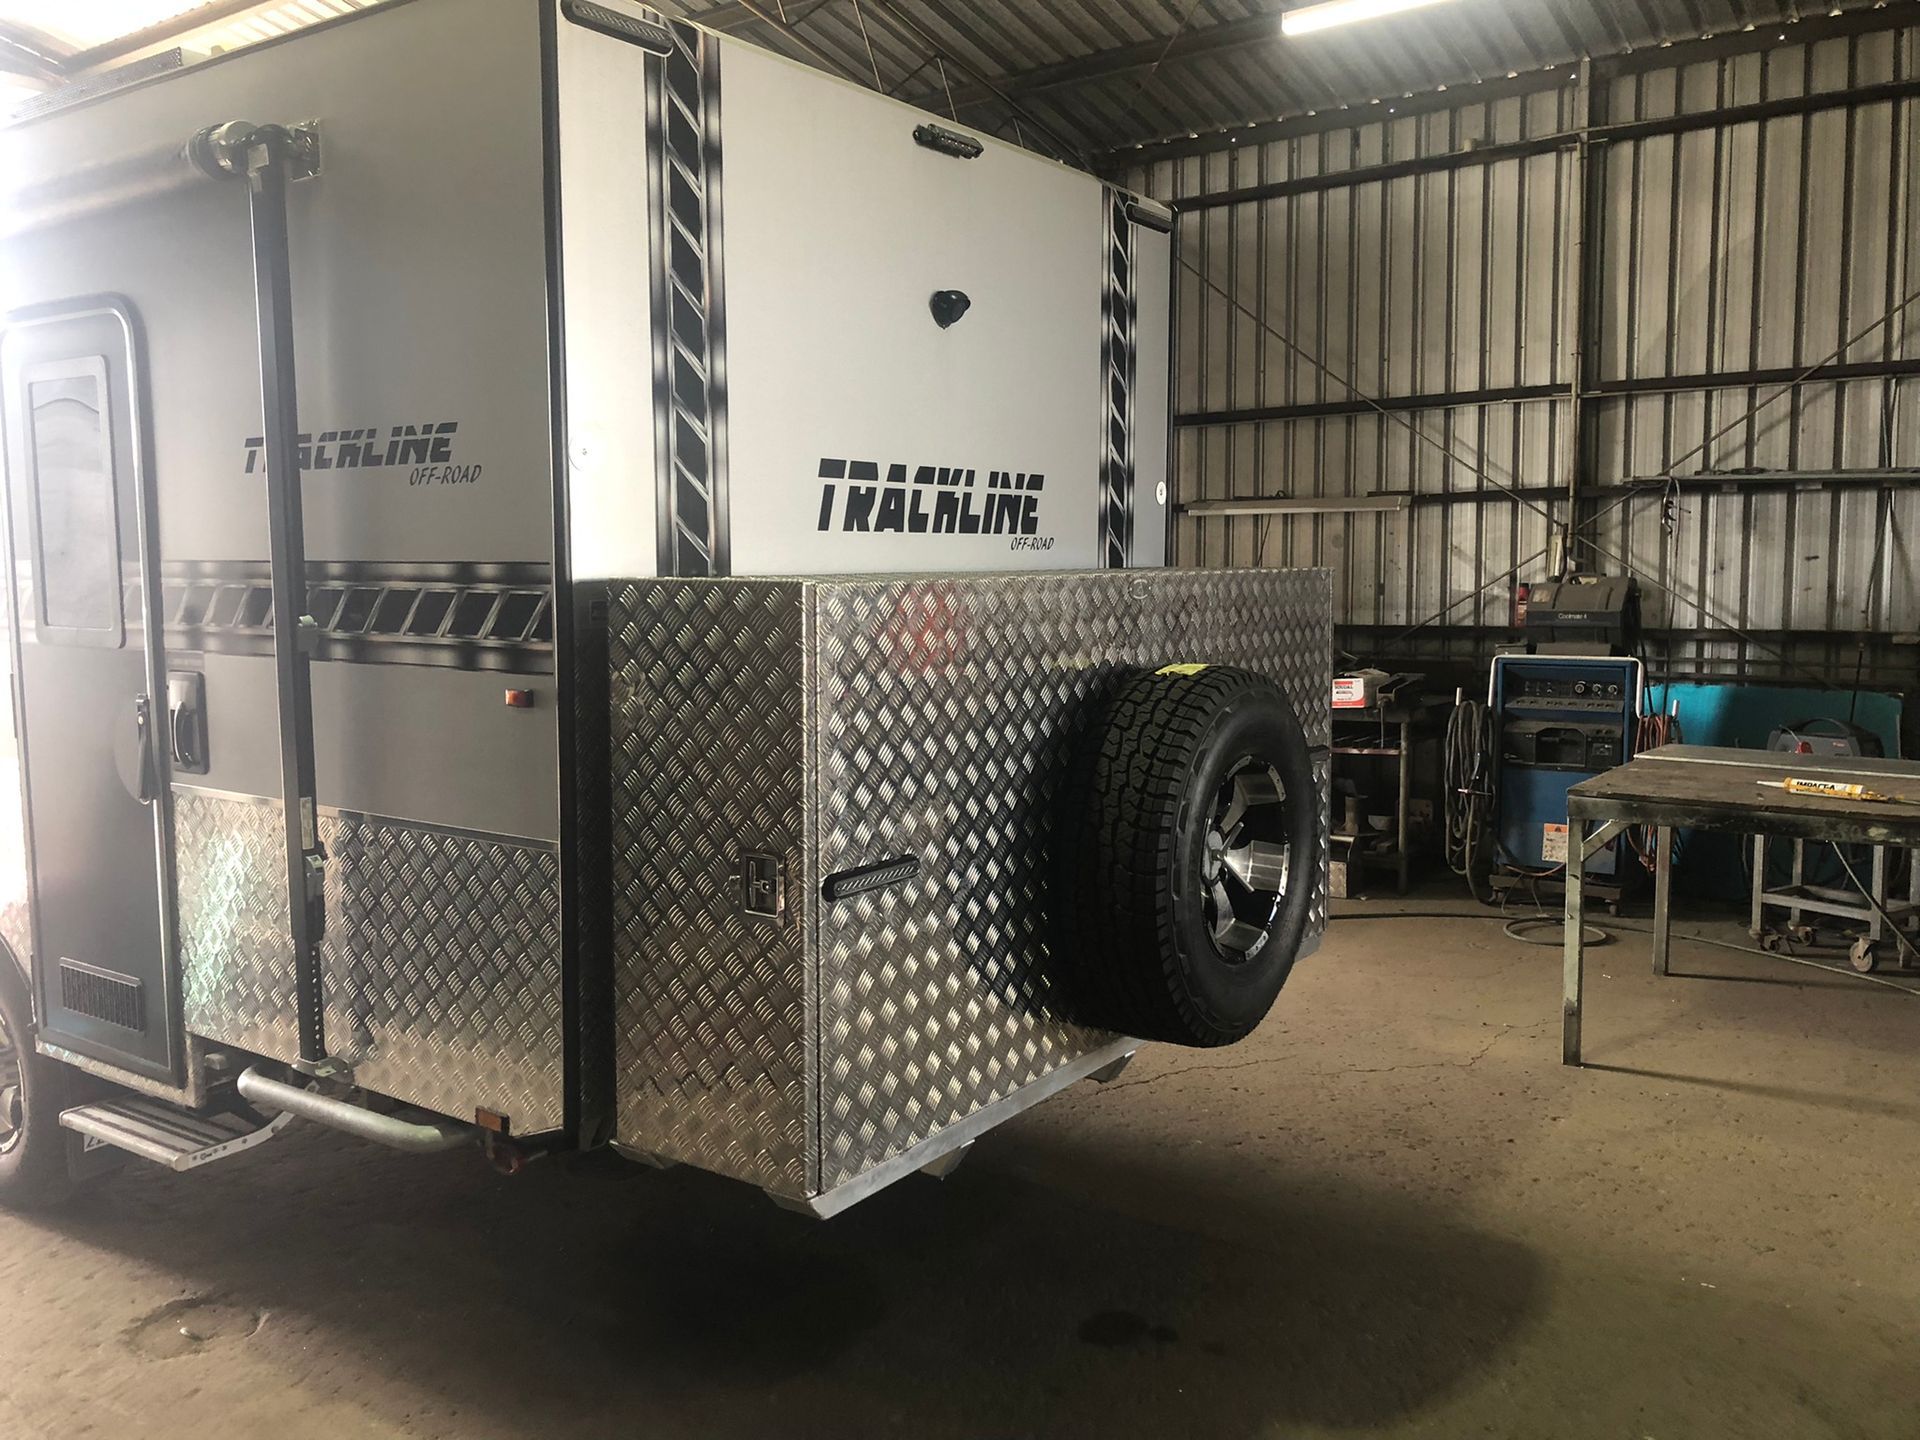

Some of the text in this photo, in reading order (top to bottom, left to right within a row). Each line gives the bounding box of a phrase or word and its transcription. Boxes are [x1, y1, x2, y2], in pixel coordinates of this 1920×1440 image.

[244, 421, 458, 474] TACKLINE
[409, 464, 482, 486] OFF-ROAD
[817, 457, 1045, 535] TRACKLINE
[1010, 536, 1055, 551] OFF-ROAD
